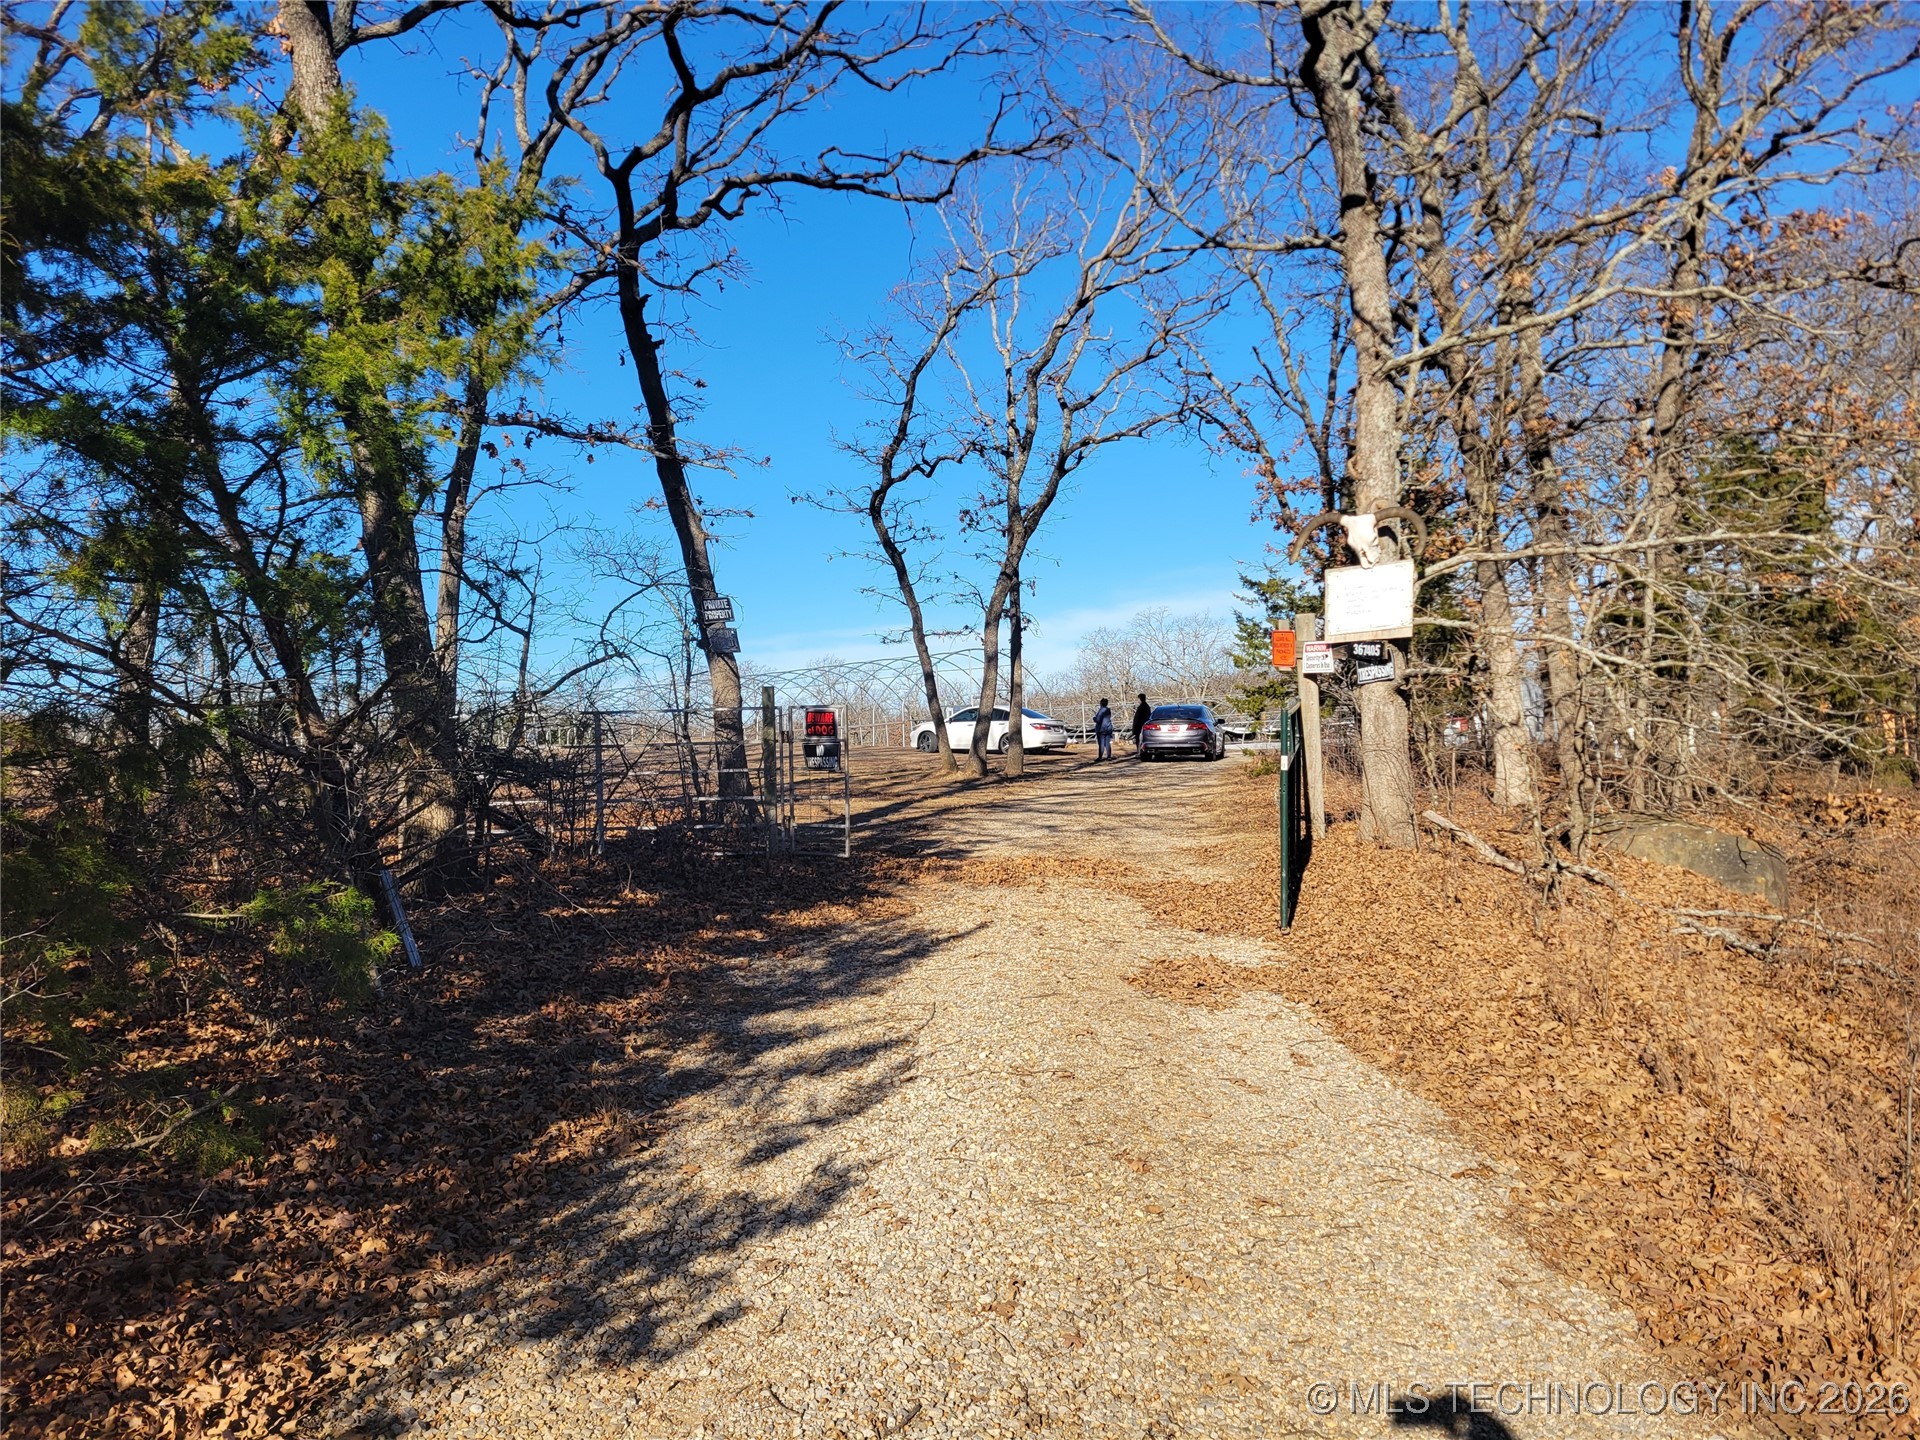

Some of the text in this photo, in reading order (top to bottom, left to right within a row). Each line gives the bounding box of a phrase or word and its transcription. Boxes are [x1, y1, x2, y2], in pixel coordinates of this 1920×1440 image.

[703, 599, 729, 610] PRIVATE
[704, 609, 732, 620] PROPERTY
[1353, 643, 1381, 657] 367405
[807, 712, 833, 723] BEWARE
[807, 725, 834, 735] of DOG
[816, 744, 825, 757] NO
[806, 756, 838, 768] TRESPASSING
